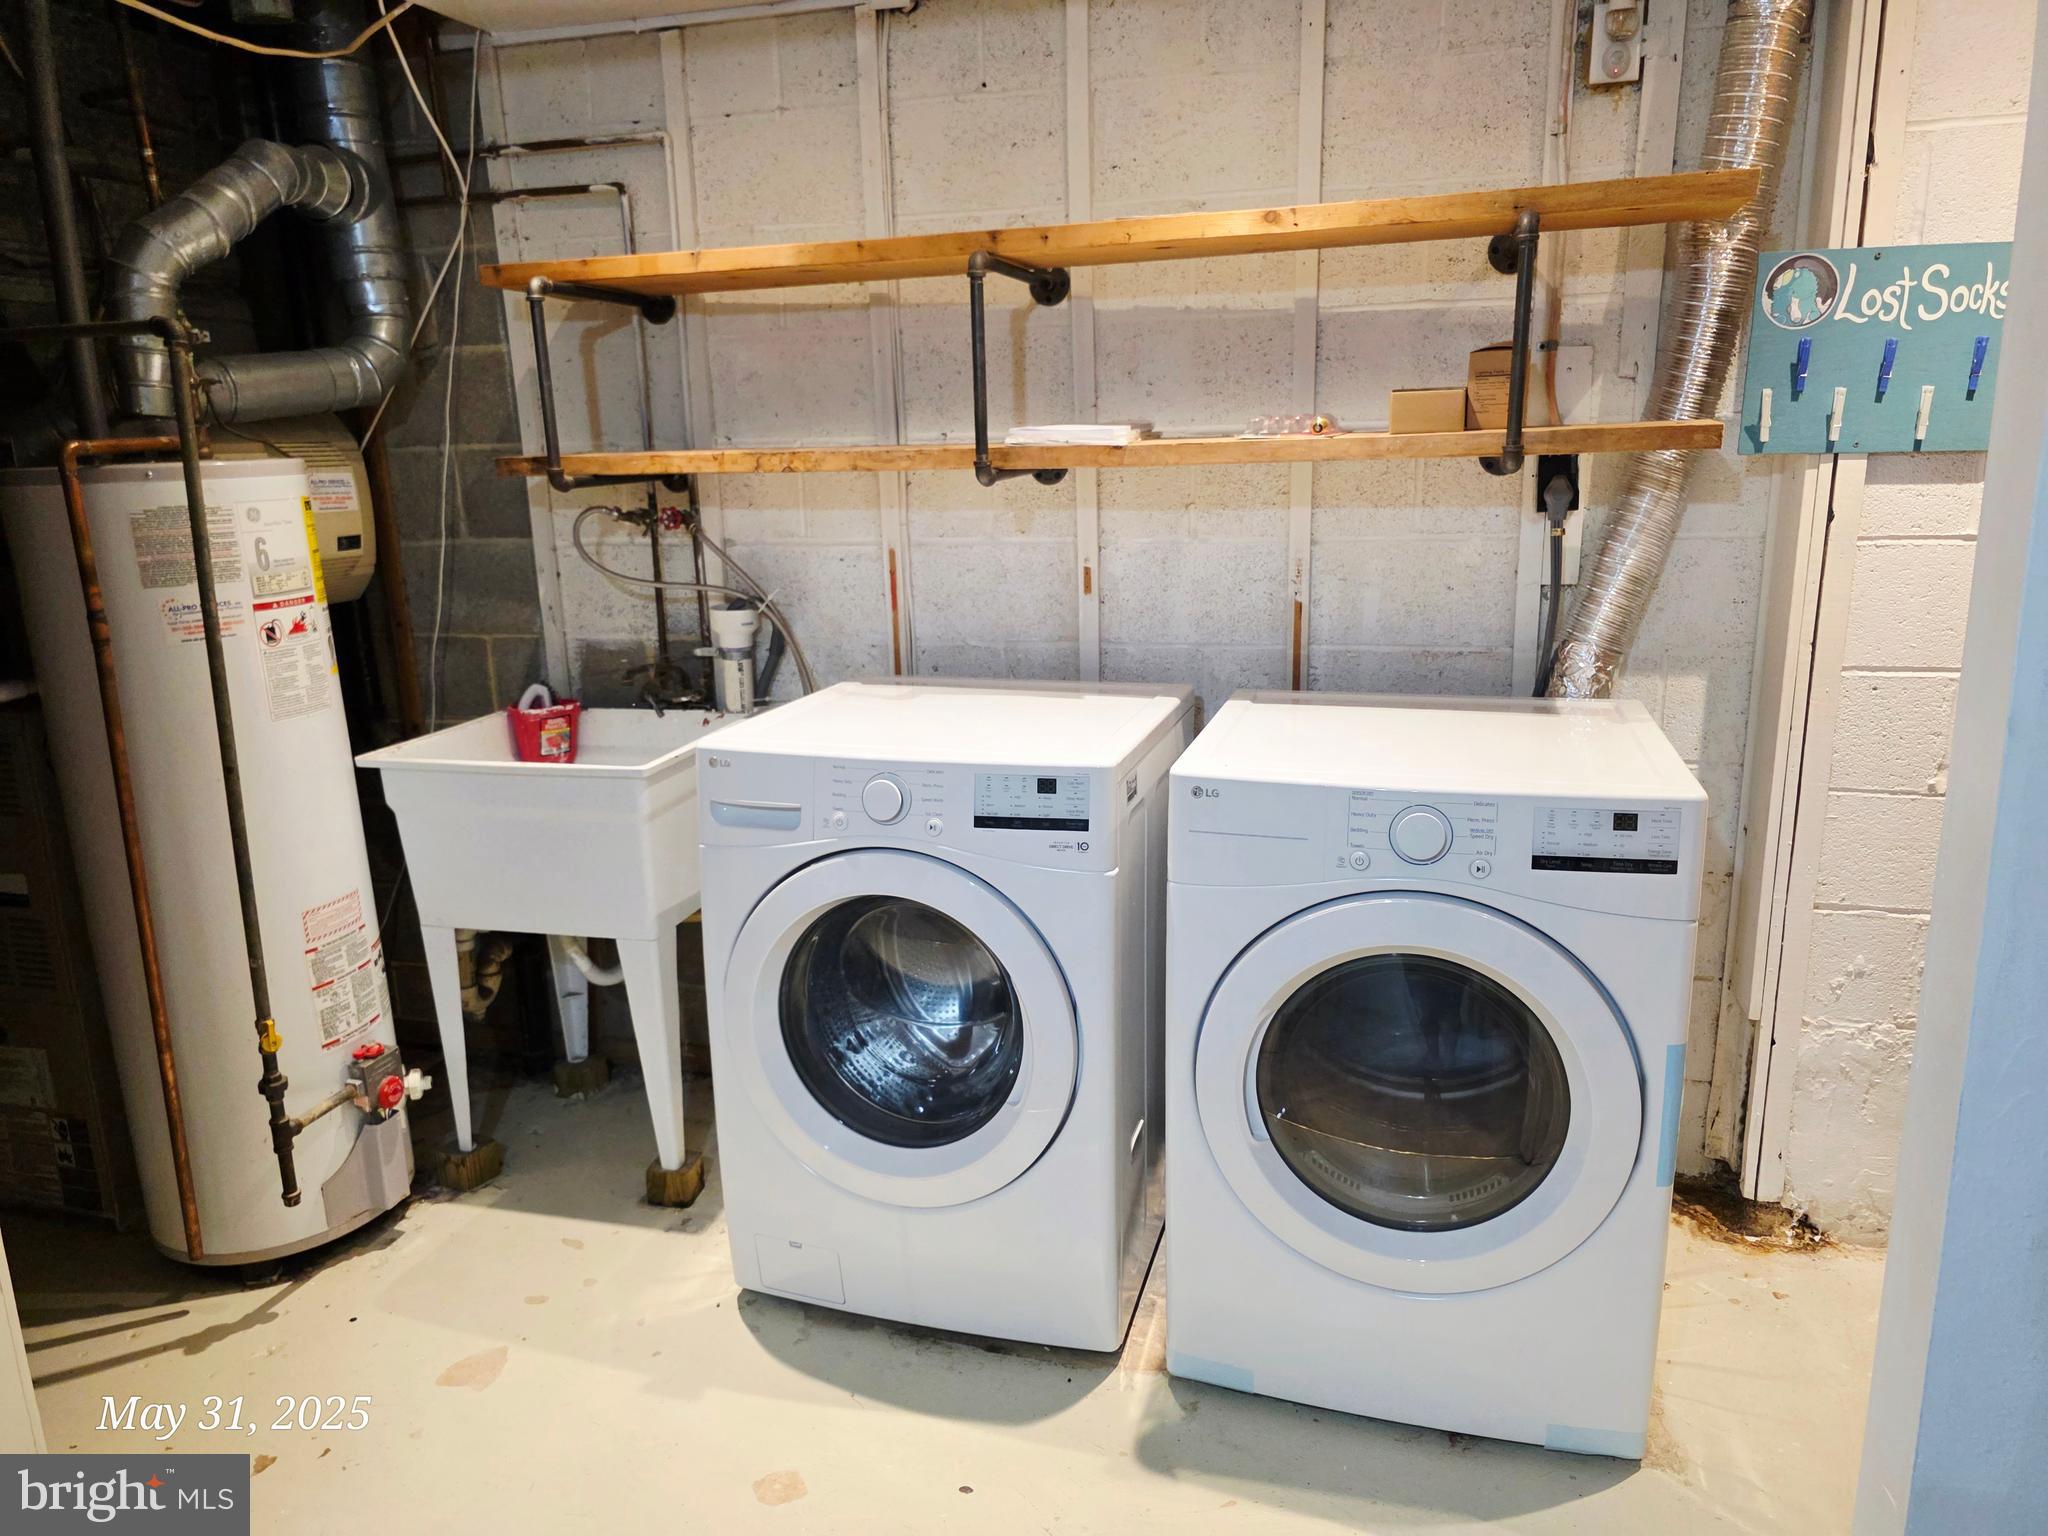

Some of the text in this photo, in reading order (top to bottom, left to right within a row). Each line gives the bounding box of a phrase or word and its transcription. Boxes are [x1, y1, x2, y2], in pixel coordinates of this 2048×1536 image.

[1833, 261, 2009, 330] Lost Socks
[254, 536, 270, 571] 6
[280, 598, 305, 609] DANGER
[1205, 788, 1220, 798] LG
